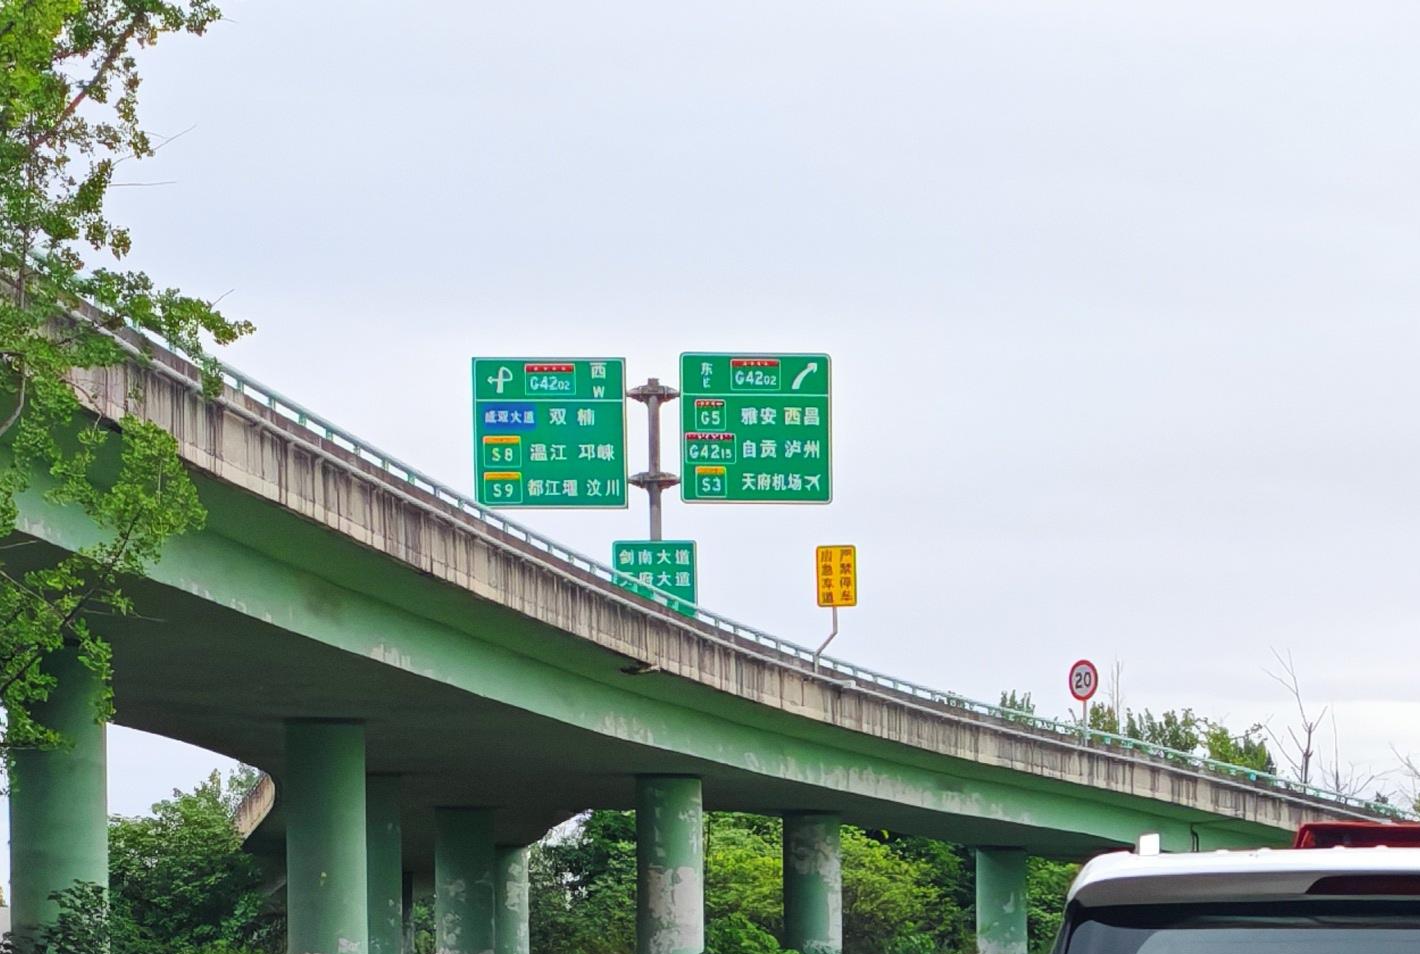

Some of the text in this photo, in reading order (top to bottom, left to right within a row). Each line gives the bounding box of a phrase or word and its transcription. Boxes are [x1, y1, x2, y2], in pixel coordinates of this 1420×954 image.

[590, 362, 607, 379] 西
[701, 362, 713, 376] 东
[530, 376, 571, 391] G4202
[735, 370, 777, 386] G4202
[593, 386, 605, 398] W
[701, 411, 721, 426] G5
[741, 407, 820, 427] 雅安 西昌
[491, 447, 513, 462] S8
[530, 443, 615, 462] 温江 邛崃
[689, 444, 732, 460] G4215
[742, 440, 820, 459] 自贡 泸州
[528, 478, 620, 497] 都江堰 汶川
[702, 476, 722, 492] S3
[741, 472, 802, 491] 天府机场
[493, 483, 514, 498] S9
[619, 549, 690, 565] 剑南大道
[1075, 671, 1092, 689] 20
